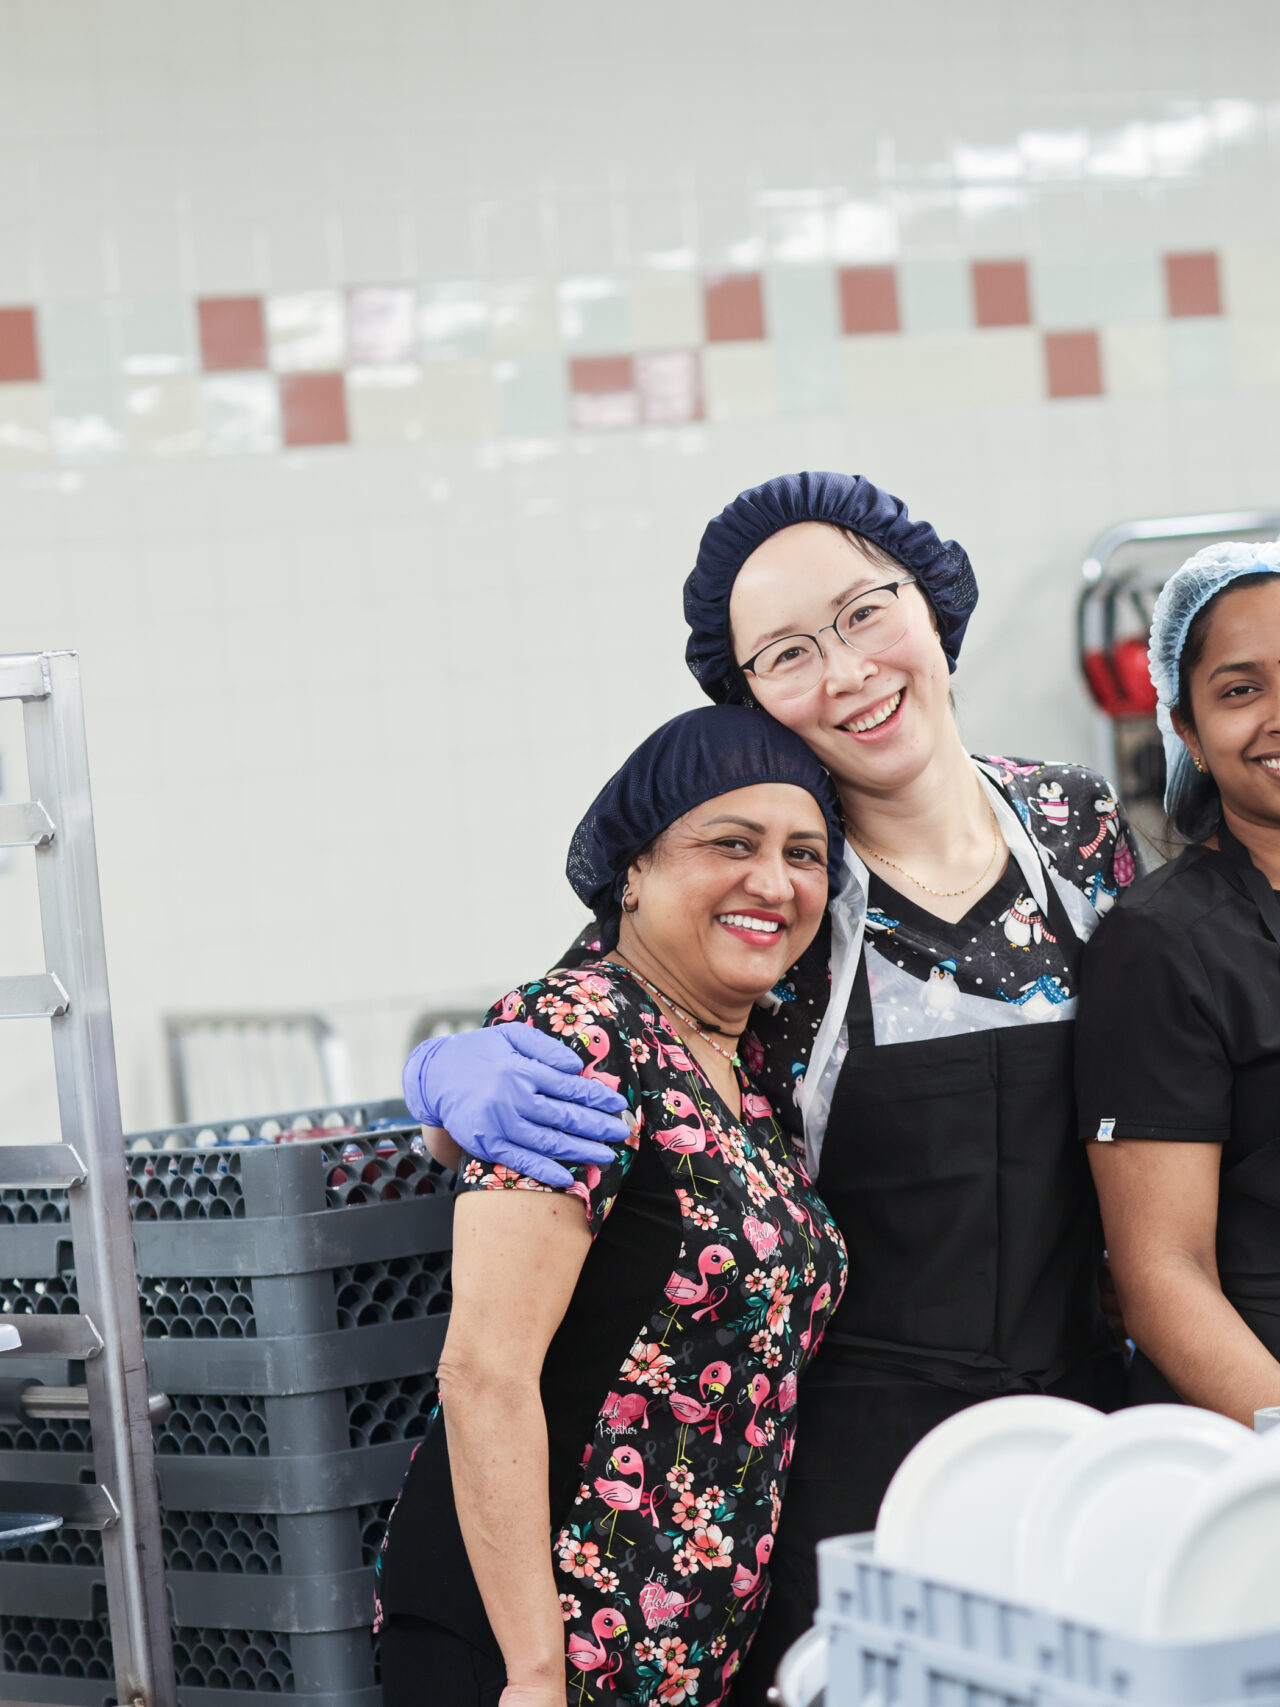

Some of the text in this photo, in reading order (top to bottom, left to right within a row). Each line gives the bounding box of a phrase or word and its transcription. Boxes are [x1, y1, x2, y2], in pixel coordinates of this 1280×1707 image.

[595, 1418, 638, 1445] Together
[644, 1566, 669, 1587] Let's
[639, 1586, 674, 1610] Flock
[643, 1606, 680, 1634] Together
